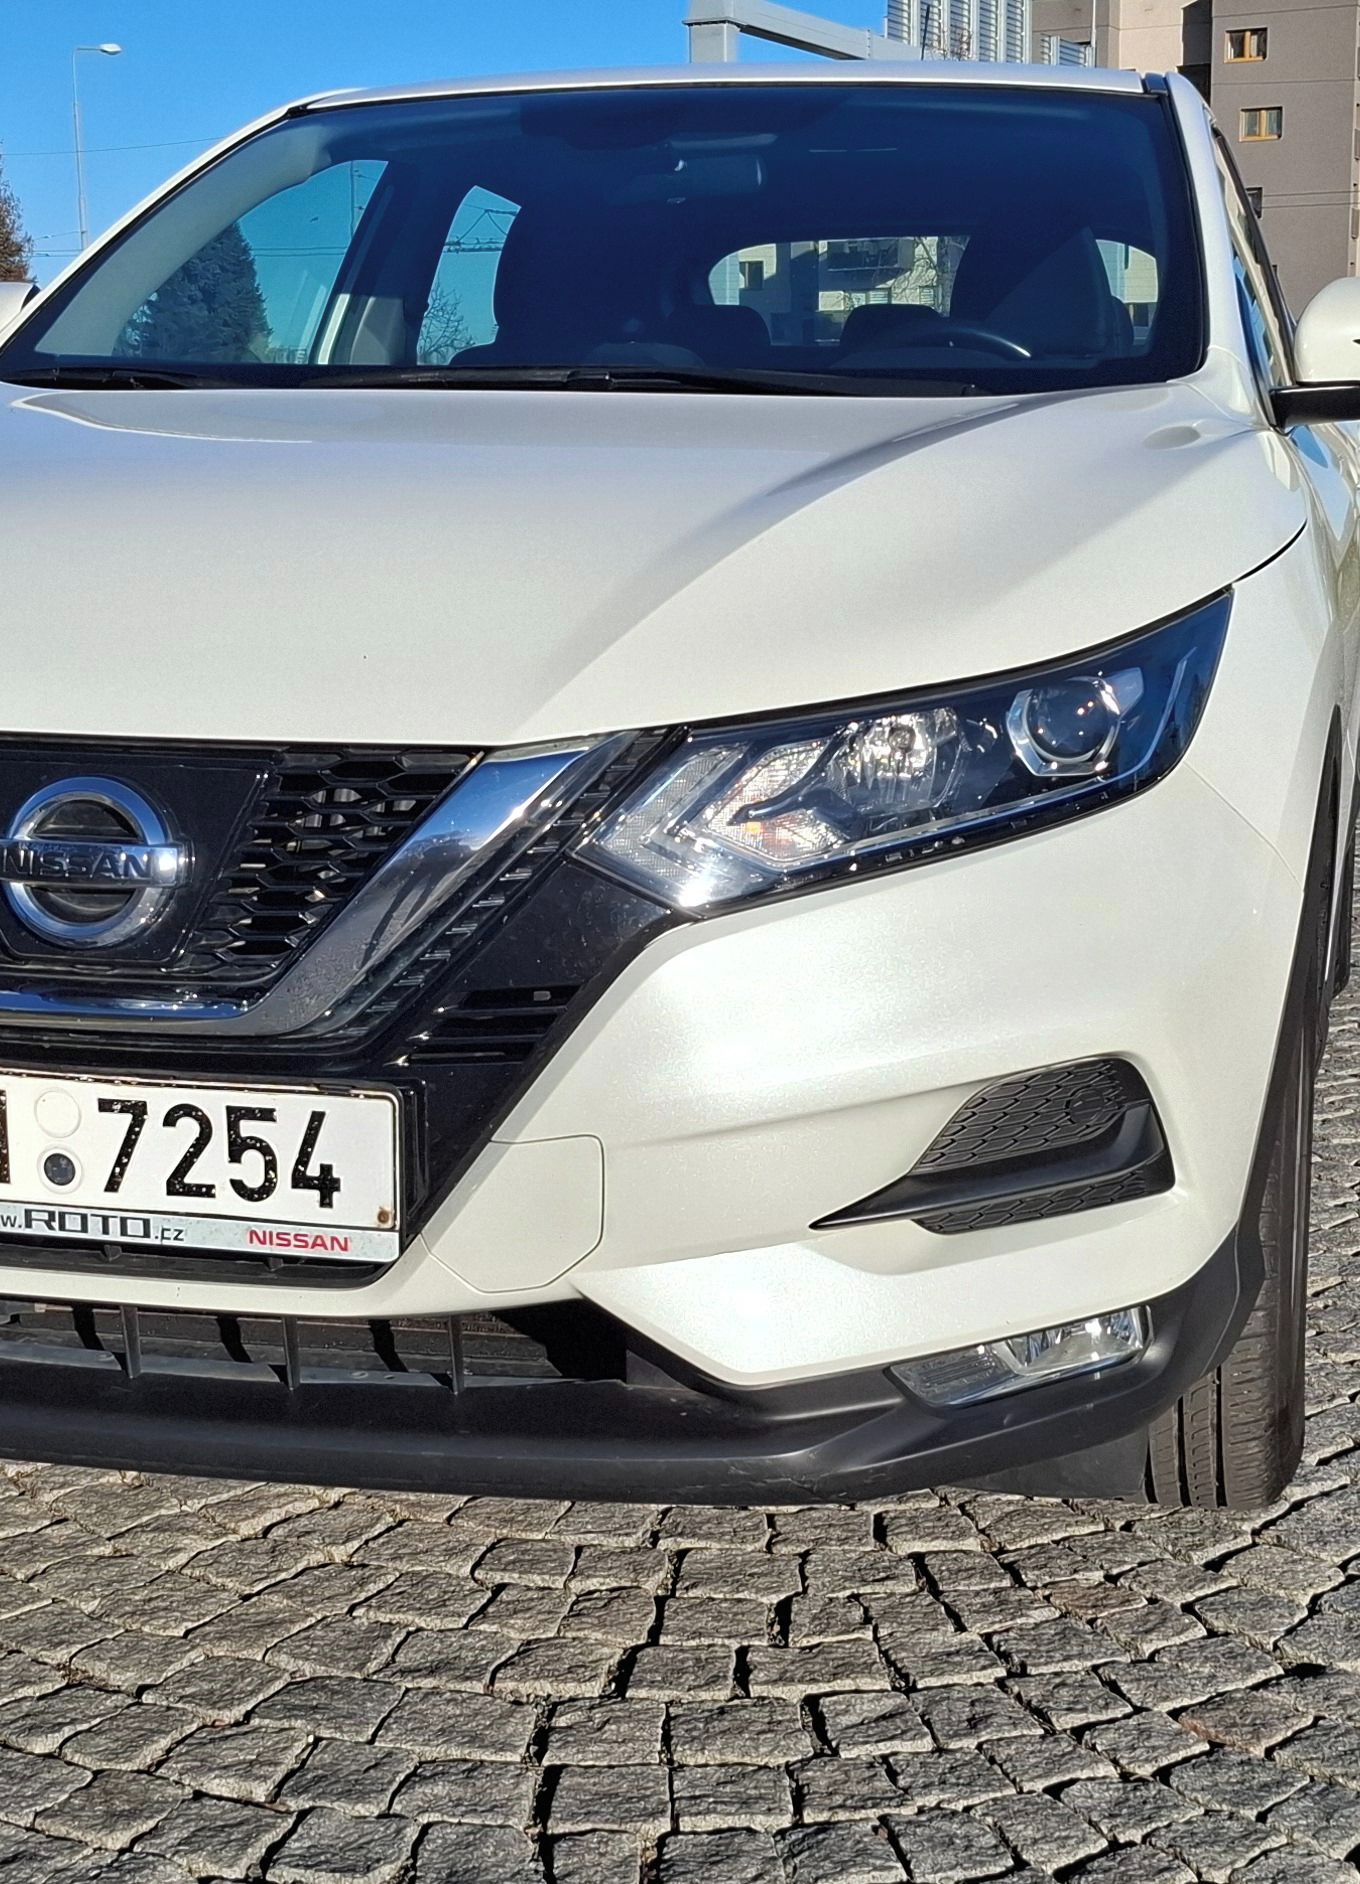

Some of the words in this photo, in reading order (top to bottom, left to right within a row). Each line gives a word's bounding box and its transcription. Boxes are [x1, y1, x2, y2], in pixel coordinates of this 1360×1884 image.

[2, 847, 153, 880] NISSAN
[97, 1098, 341, 1208] 7254
[248, 1229, 350, 1253] NISSAN
